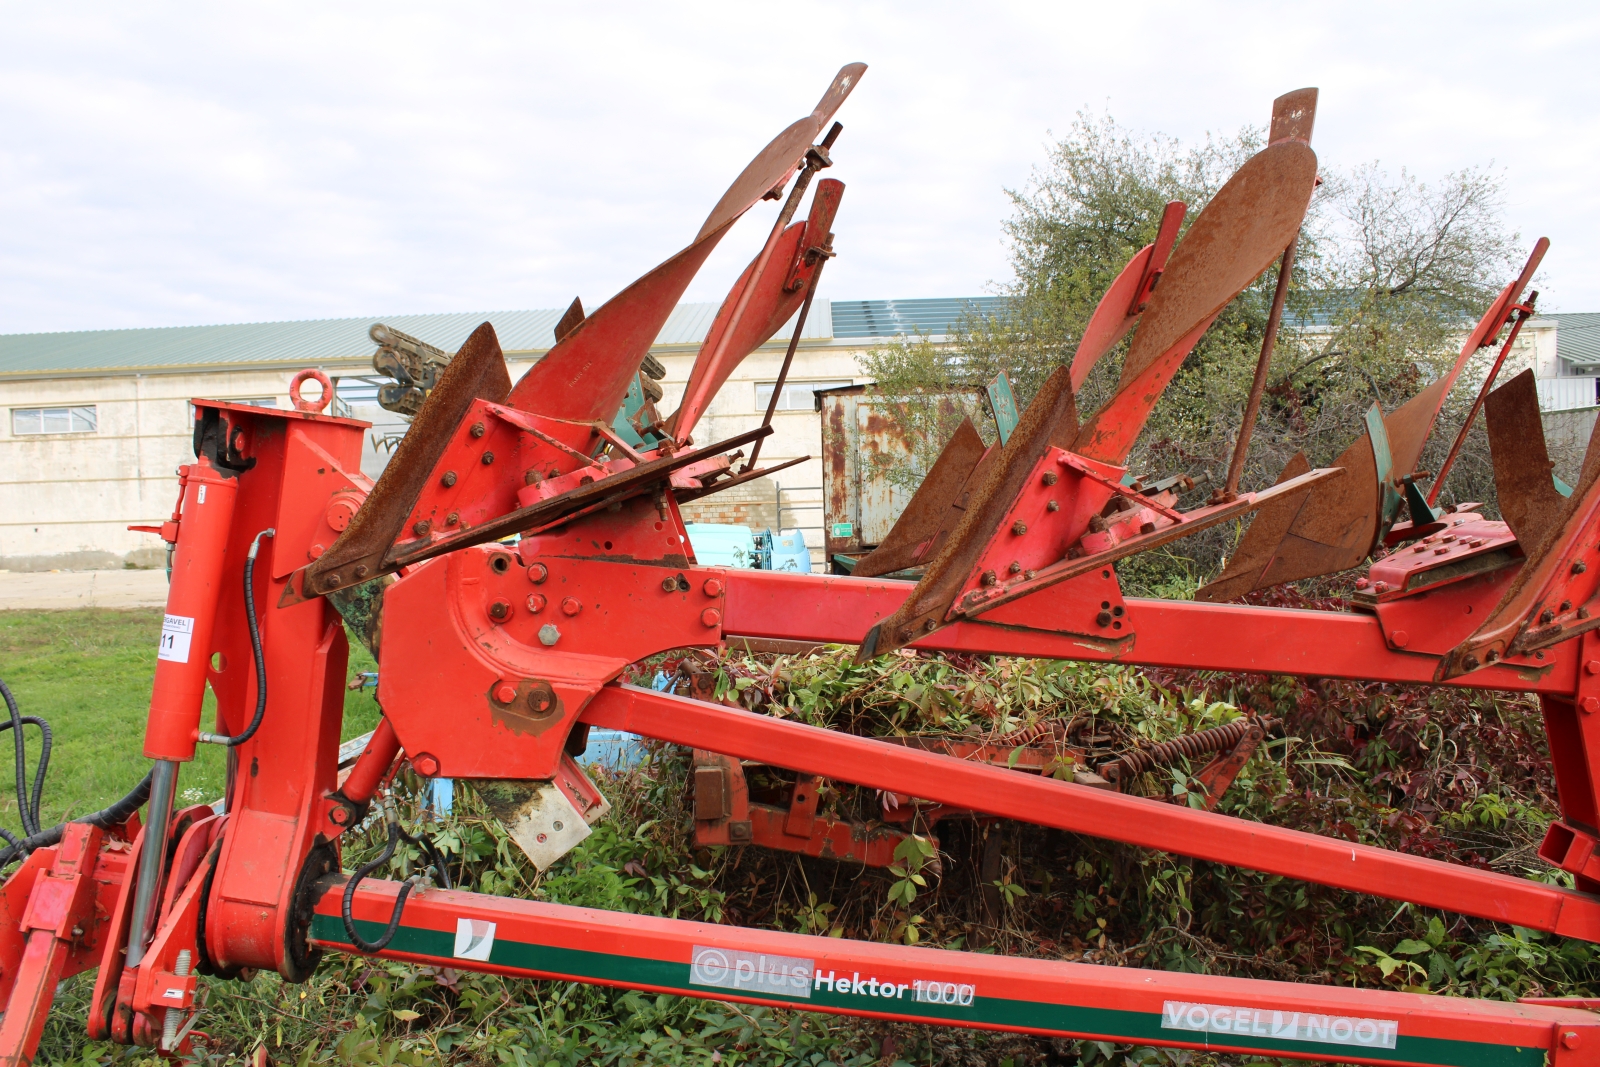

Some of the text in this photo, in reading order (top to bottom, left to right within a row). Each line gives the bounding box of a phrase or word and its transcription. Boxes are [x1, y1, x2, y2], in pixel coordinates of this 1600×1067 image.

[733, 955, 810, 988] plus
[814, 969, 908, 999] Hektor
[913, 980, 975, 1006] 1000
[1166, 1003, 1396, 1045] VOGEL NOOT
